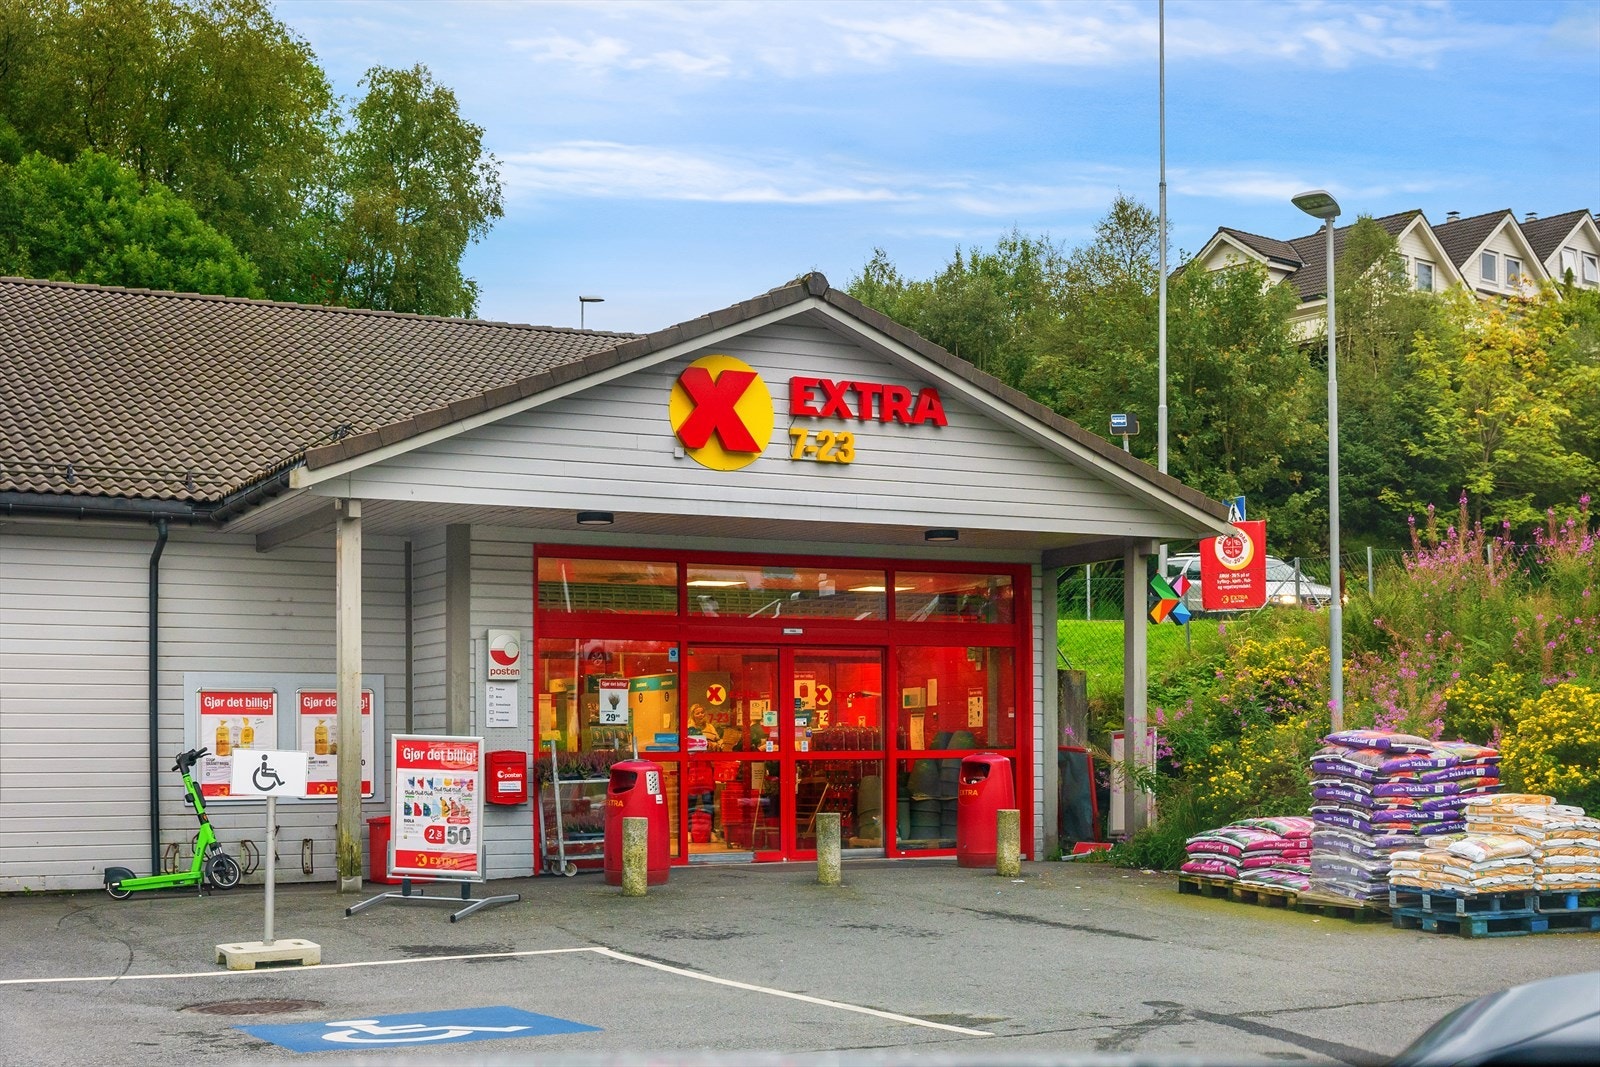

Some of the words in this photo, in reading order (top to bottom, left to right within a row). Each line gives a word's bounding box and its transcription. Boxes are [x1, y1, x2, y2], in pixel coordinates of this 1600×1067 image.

[789, 376, 949, 427] EXTRA
[676, 366, 762, 454] X
[789, 427, 856, 464] 7-23
[490, 667, 520, 677] posten
[204, 697, 226, 709] Gjør
[226, 697, 243, 708] det
[245, 697, 272, 710] billig!
[303, 697, 324, 709] Gjør
[325, 697, 337, 707] de
[606, 713, 616, 722] 29
[708, 712, 729, 723] 7-23
[403, 748, 426, 762] Gjør
[427, 749, 446, 761] det
[447, 750, 476, 764] billig!
[428, 828, 435, 840] 2
[447, 826, 472, 845] 50
[429, 857, 459, 865] EXTRA
